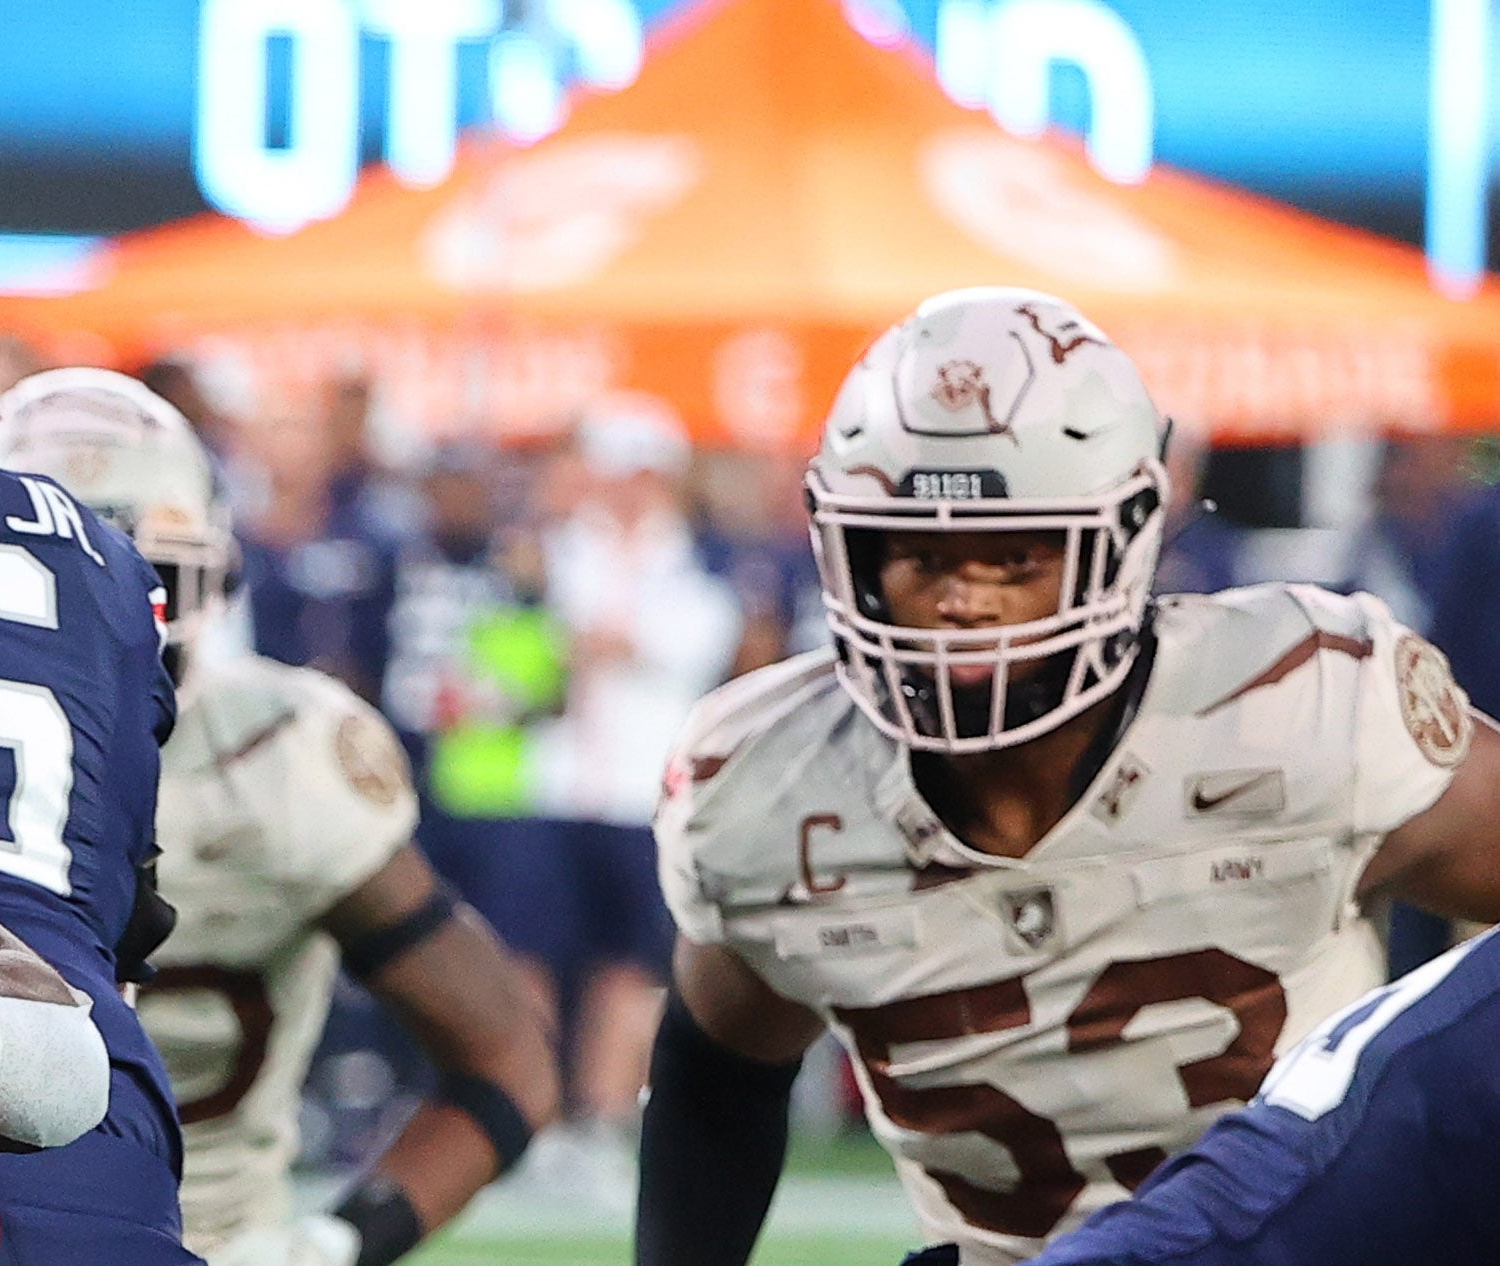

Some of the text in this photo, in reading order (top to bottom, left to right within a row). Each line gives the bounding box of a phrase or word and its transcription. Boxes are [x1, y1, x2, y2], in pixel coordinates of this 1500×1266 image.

[5, 476, 106, 567] JR
[799, 814, 846, 894] C
[834, 947, 1287, 1238] 53
